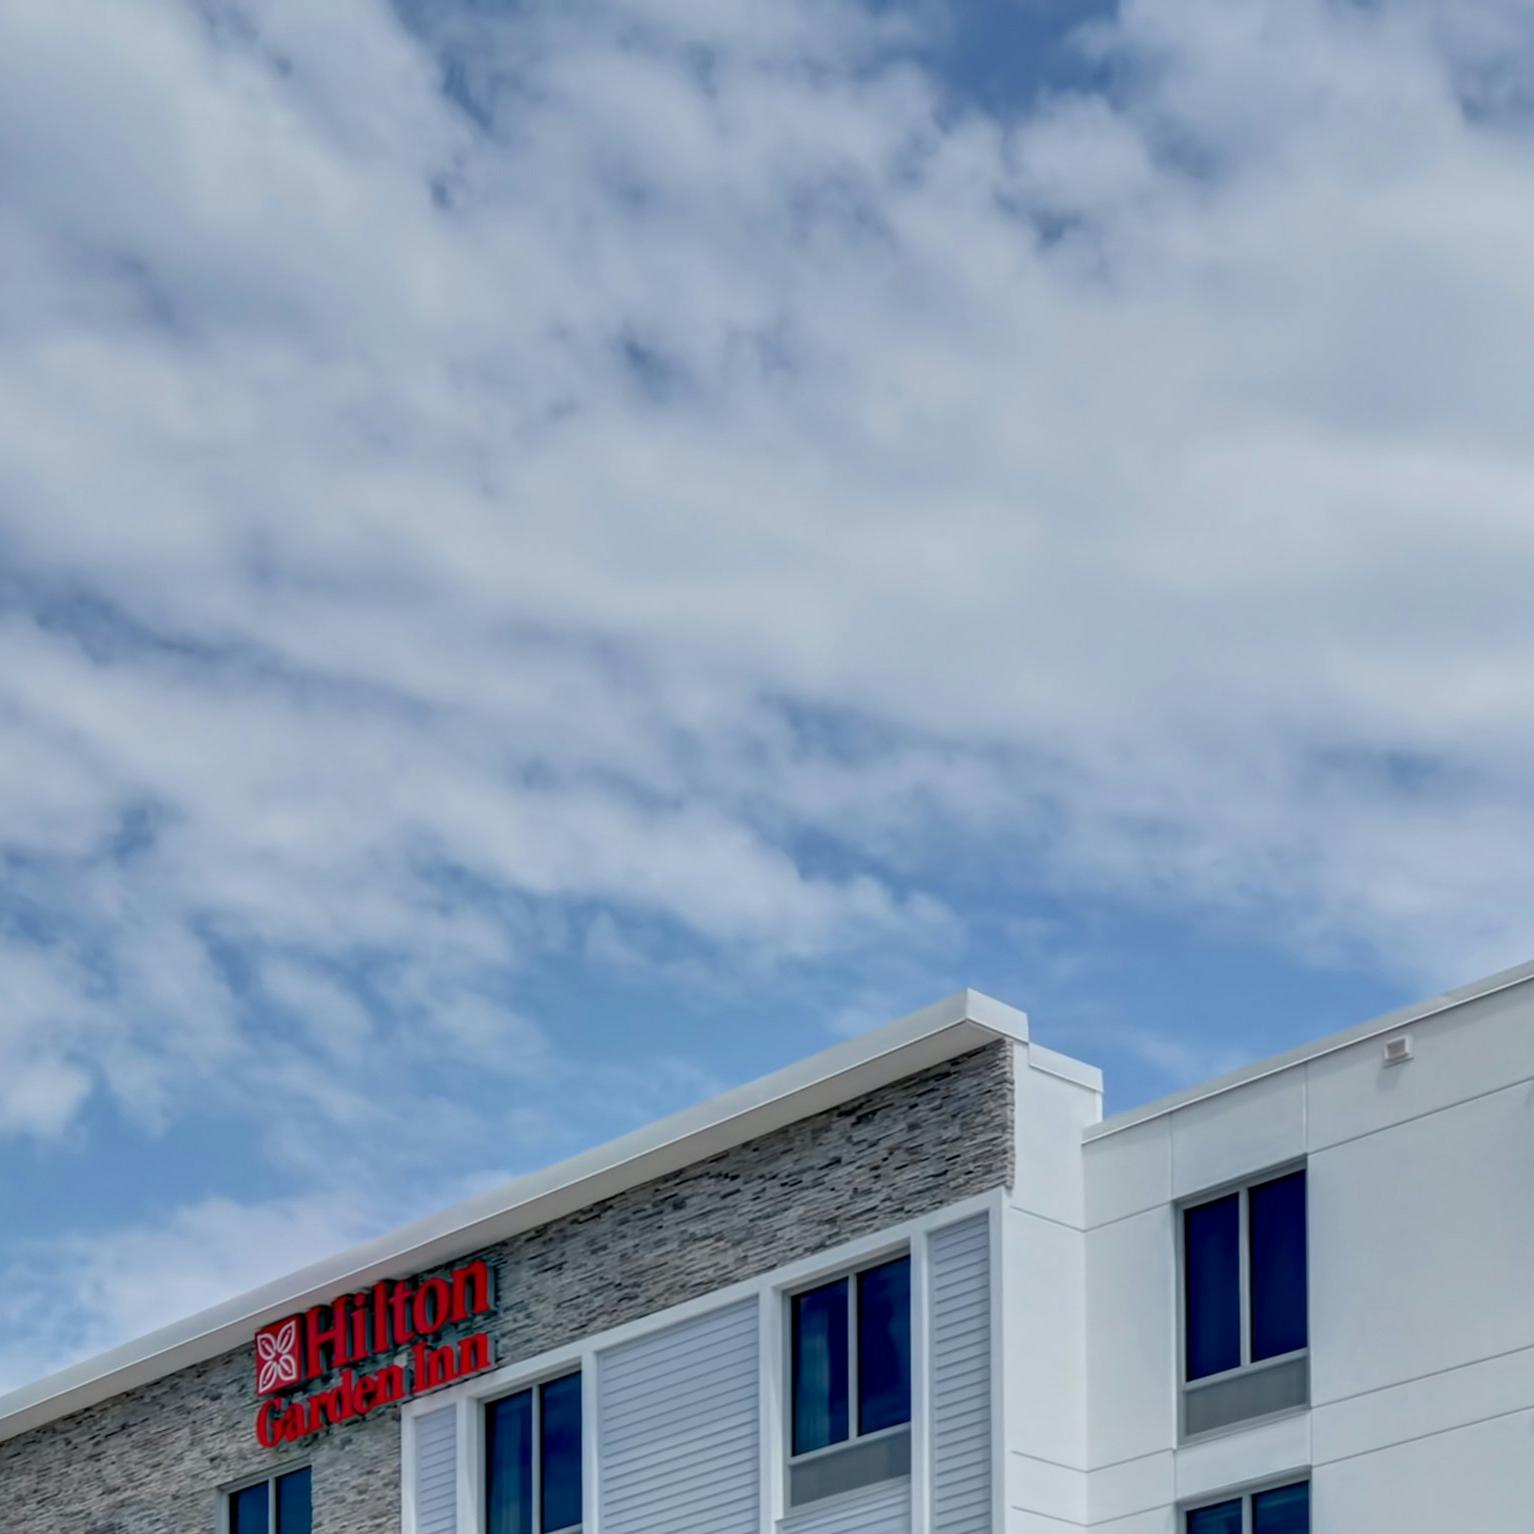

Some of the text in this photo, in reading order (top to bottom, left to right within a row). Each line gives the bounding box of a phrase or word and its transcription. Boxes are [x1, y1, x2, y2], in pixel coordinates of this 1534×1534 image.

[305, 1259, 492, 1380] Hilton
[255, 1332, 492, 1449] Garden Inn
